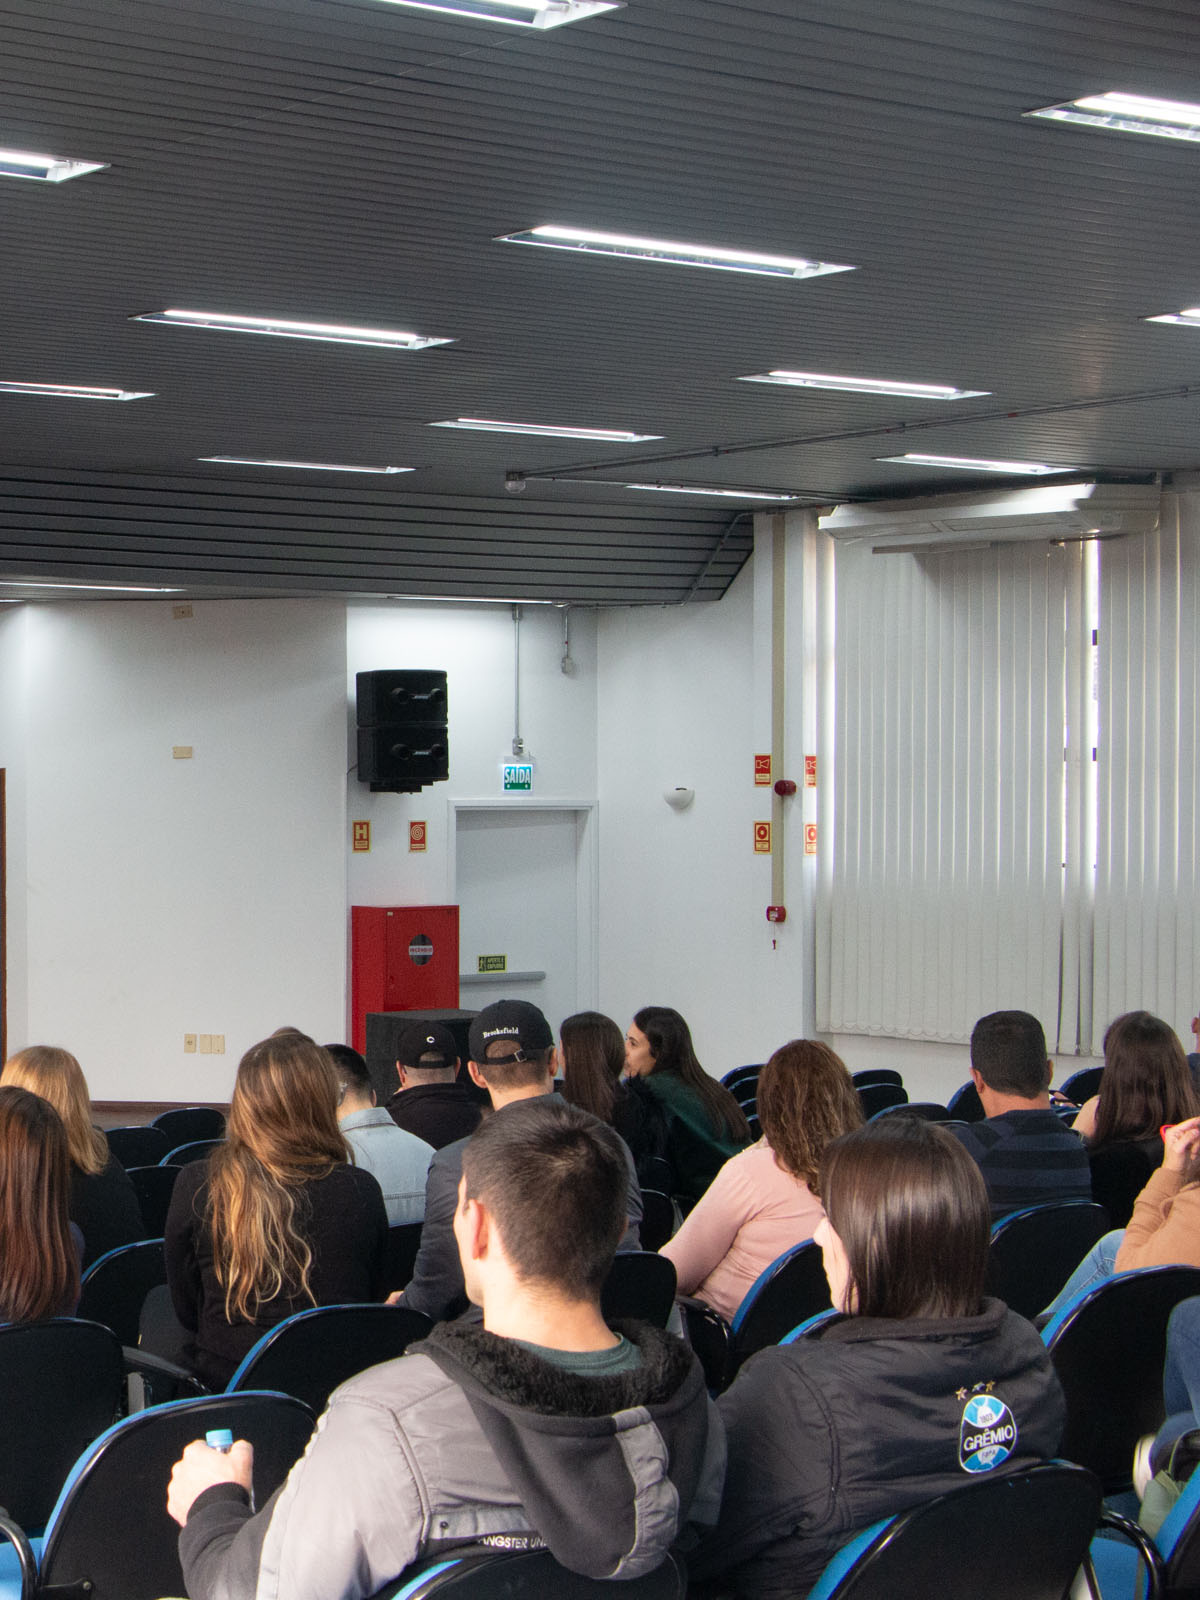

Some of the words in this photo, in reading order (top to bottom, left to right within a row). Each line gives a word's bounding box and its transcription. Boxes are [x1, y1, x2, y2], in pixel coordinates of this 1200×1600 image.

[504, 766, 531, 784] SAÍDA
[482, 1026, 520, 1039] Brooksfield
[963, 1424, 1014, 1452] GRÊMIO
